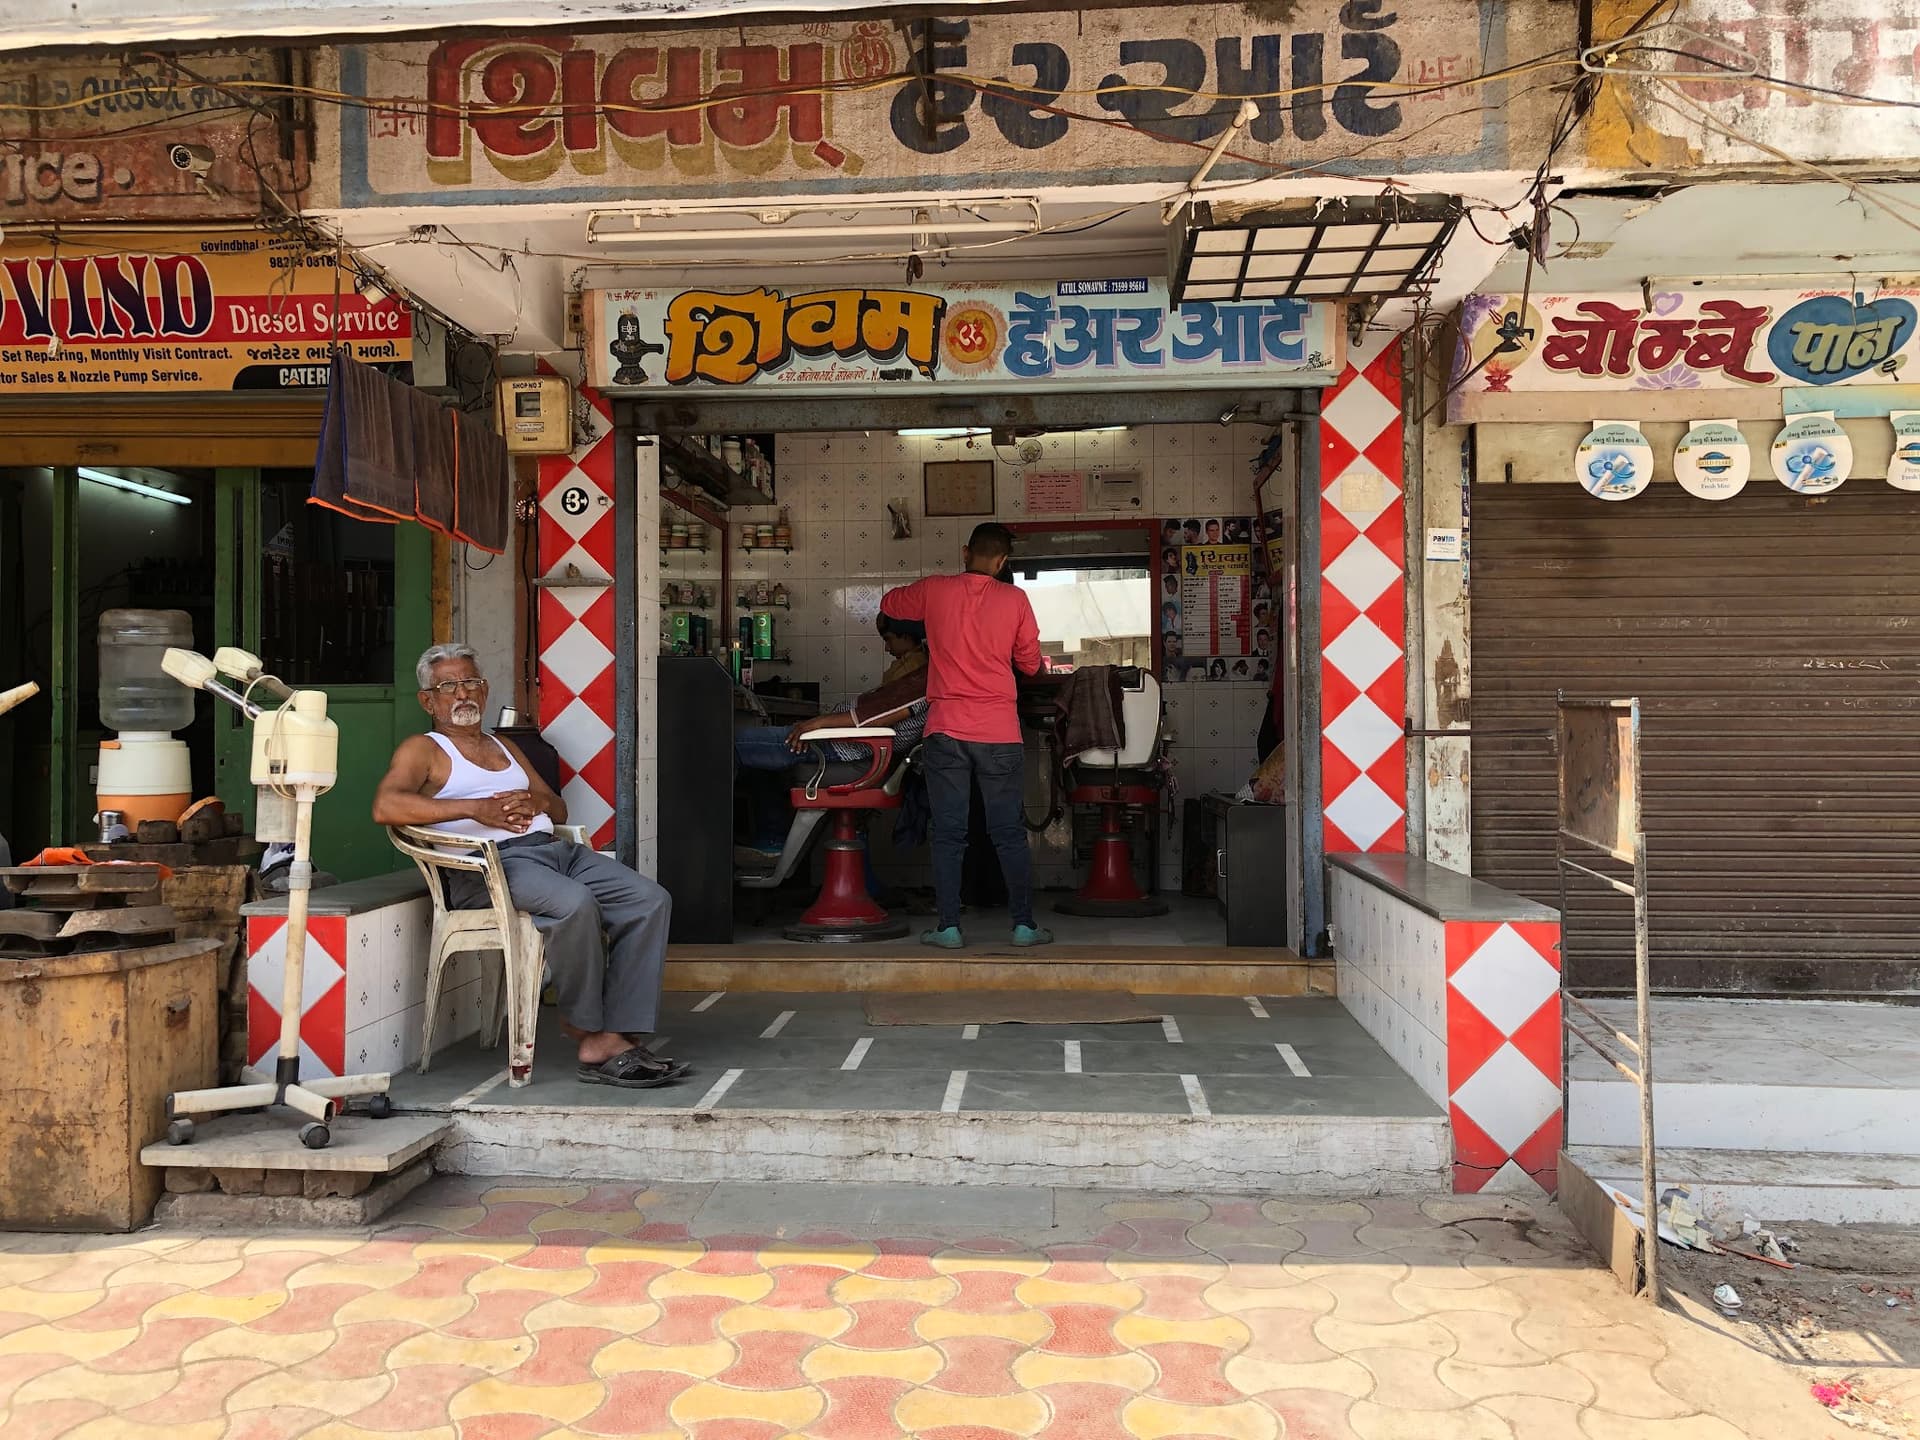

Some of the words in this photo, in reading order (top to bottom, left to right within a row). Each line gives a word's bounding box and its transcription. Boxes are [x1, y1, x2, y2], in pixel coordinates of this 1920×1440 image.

[0, 253, 215, 340] VIND
[1060, 281, 1077, 294] ATUL
[229, 303, 306, 334] Diesel
[312, 302, 400, 333] Service
[2, 350, 22, 363] Set
[91, 347, 140, 363] Monthly
[143, 347, 172, 361] Visit
[175, 346, 233, 361] Contract.
[1789, 316, 1907, 375] पान
[21, 371, 54, 384] Sales
[57, 371, 67, 383] &
[70, 370, 110, 383] Nozzle
[114, 370, 148, 385] Pump
[152, 368, 202, 383] Service.
[565, 489, 581, 513] 3
